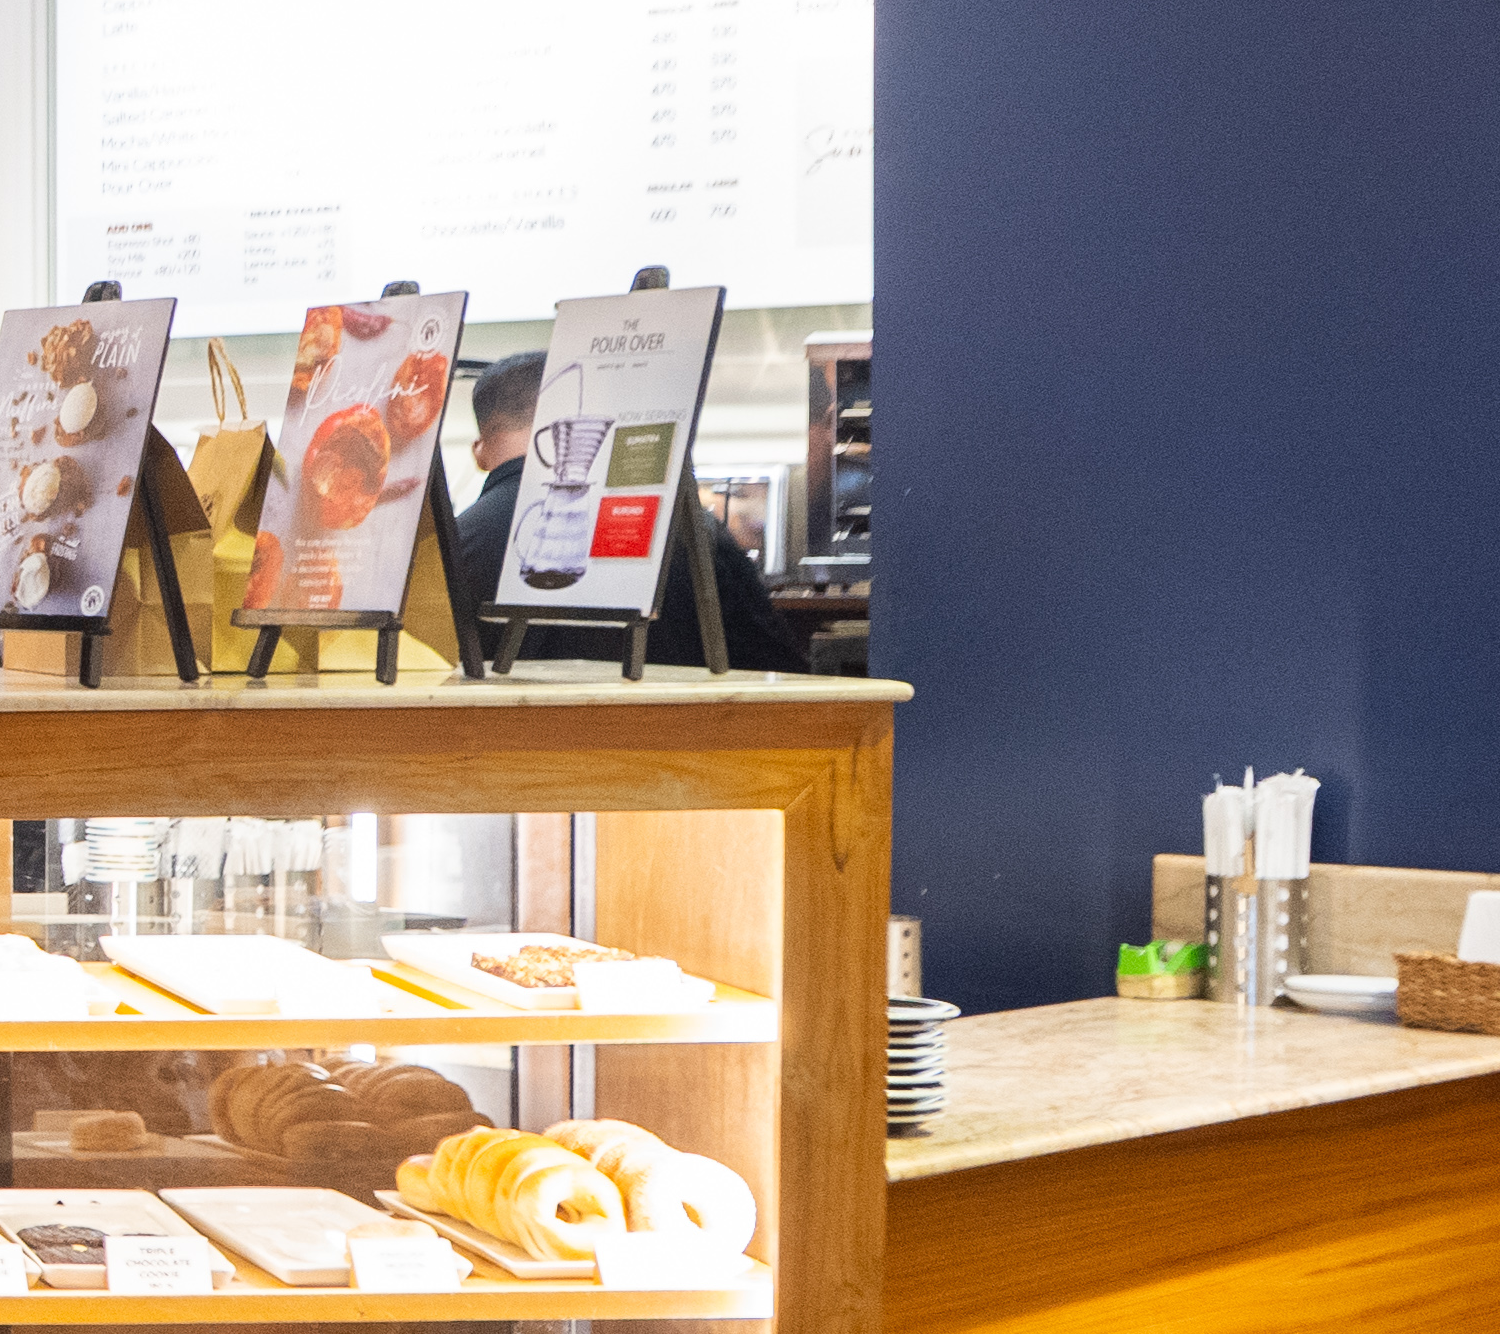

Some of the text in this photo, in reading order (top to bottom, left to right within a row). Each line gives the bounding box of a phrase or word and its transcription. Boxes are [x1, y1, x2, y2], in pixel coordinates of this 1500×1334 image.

[623, 319, 640, 331] THE
[590, 332, 666, 354] POUR OVER
[91, 341, 142, 369] PLAIN
